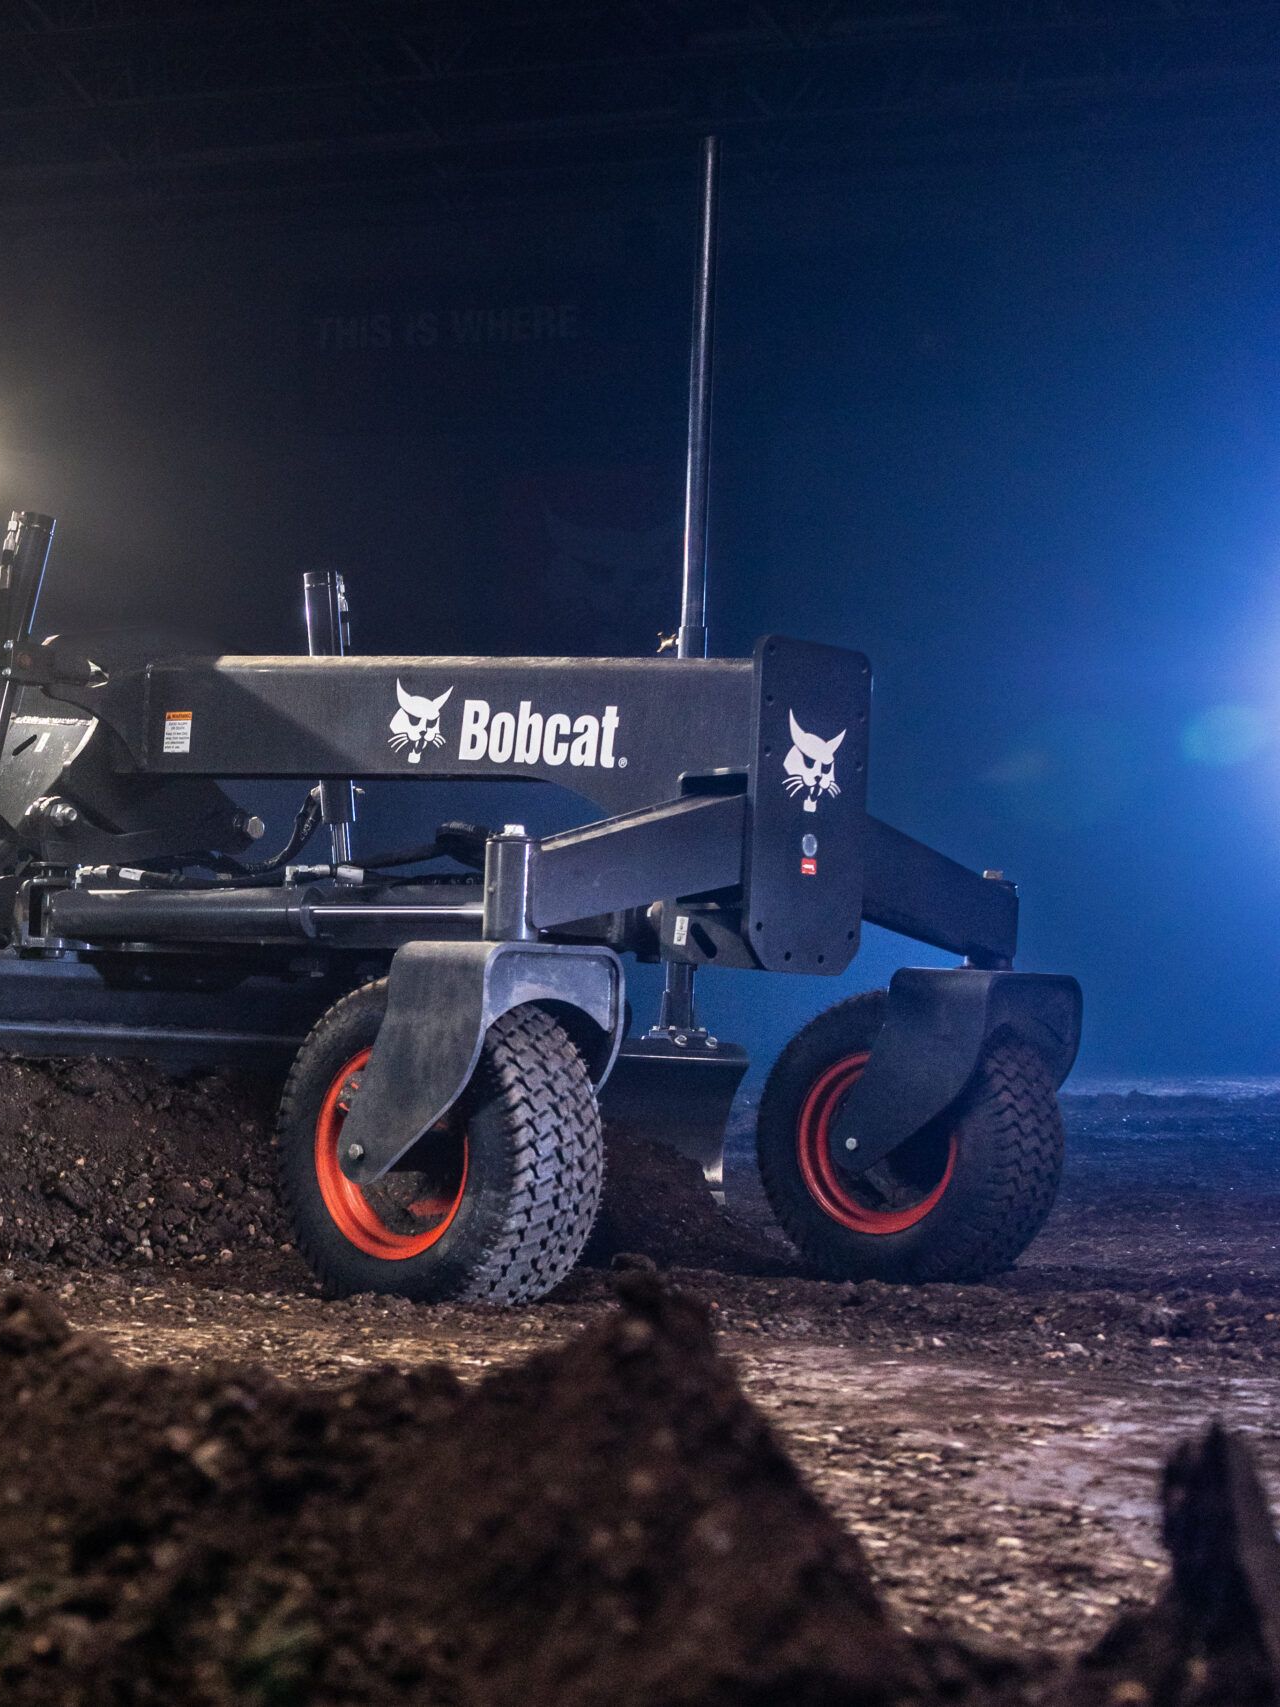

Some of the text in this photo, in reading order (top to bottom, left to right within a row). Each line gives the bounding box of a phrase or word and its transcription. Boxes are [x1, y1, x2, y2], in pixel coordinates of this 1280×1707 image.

[315, 304, 579, 350] THIS IS WHERE
[458, 699, 619, 769] Bobcat
